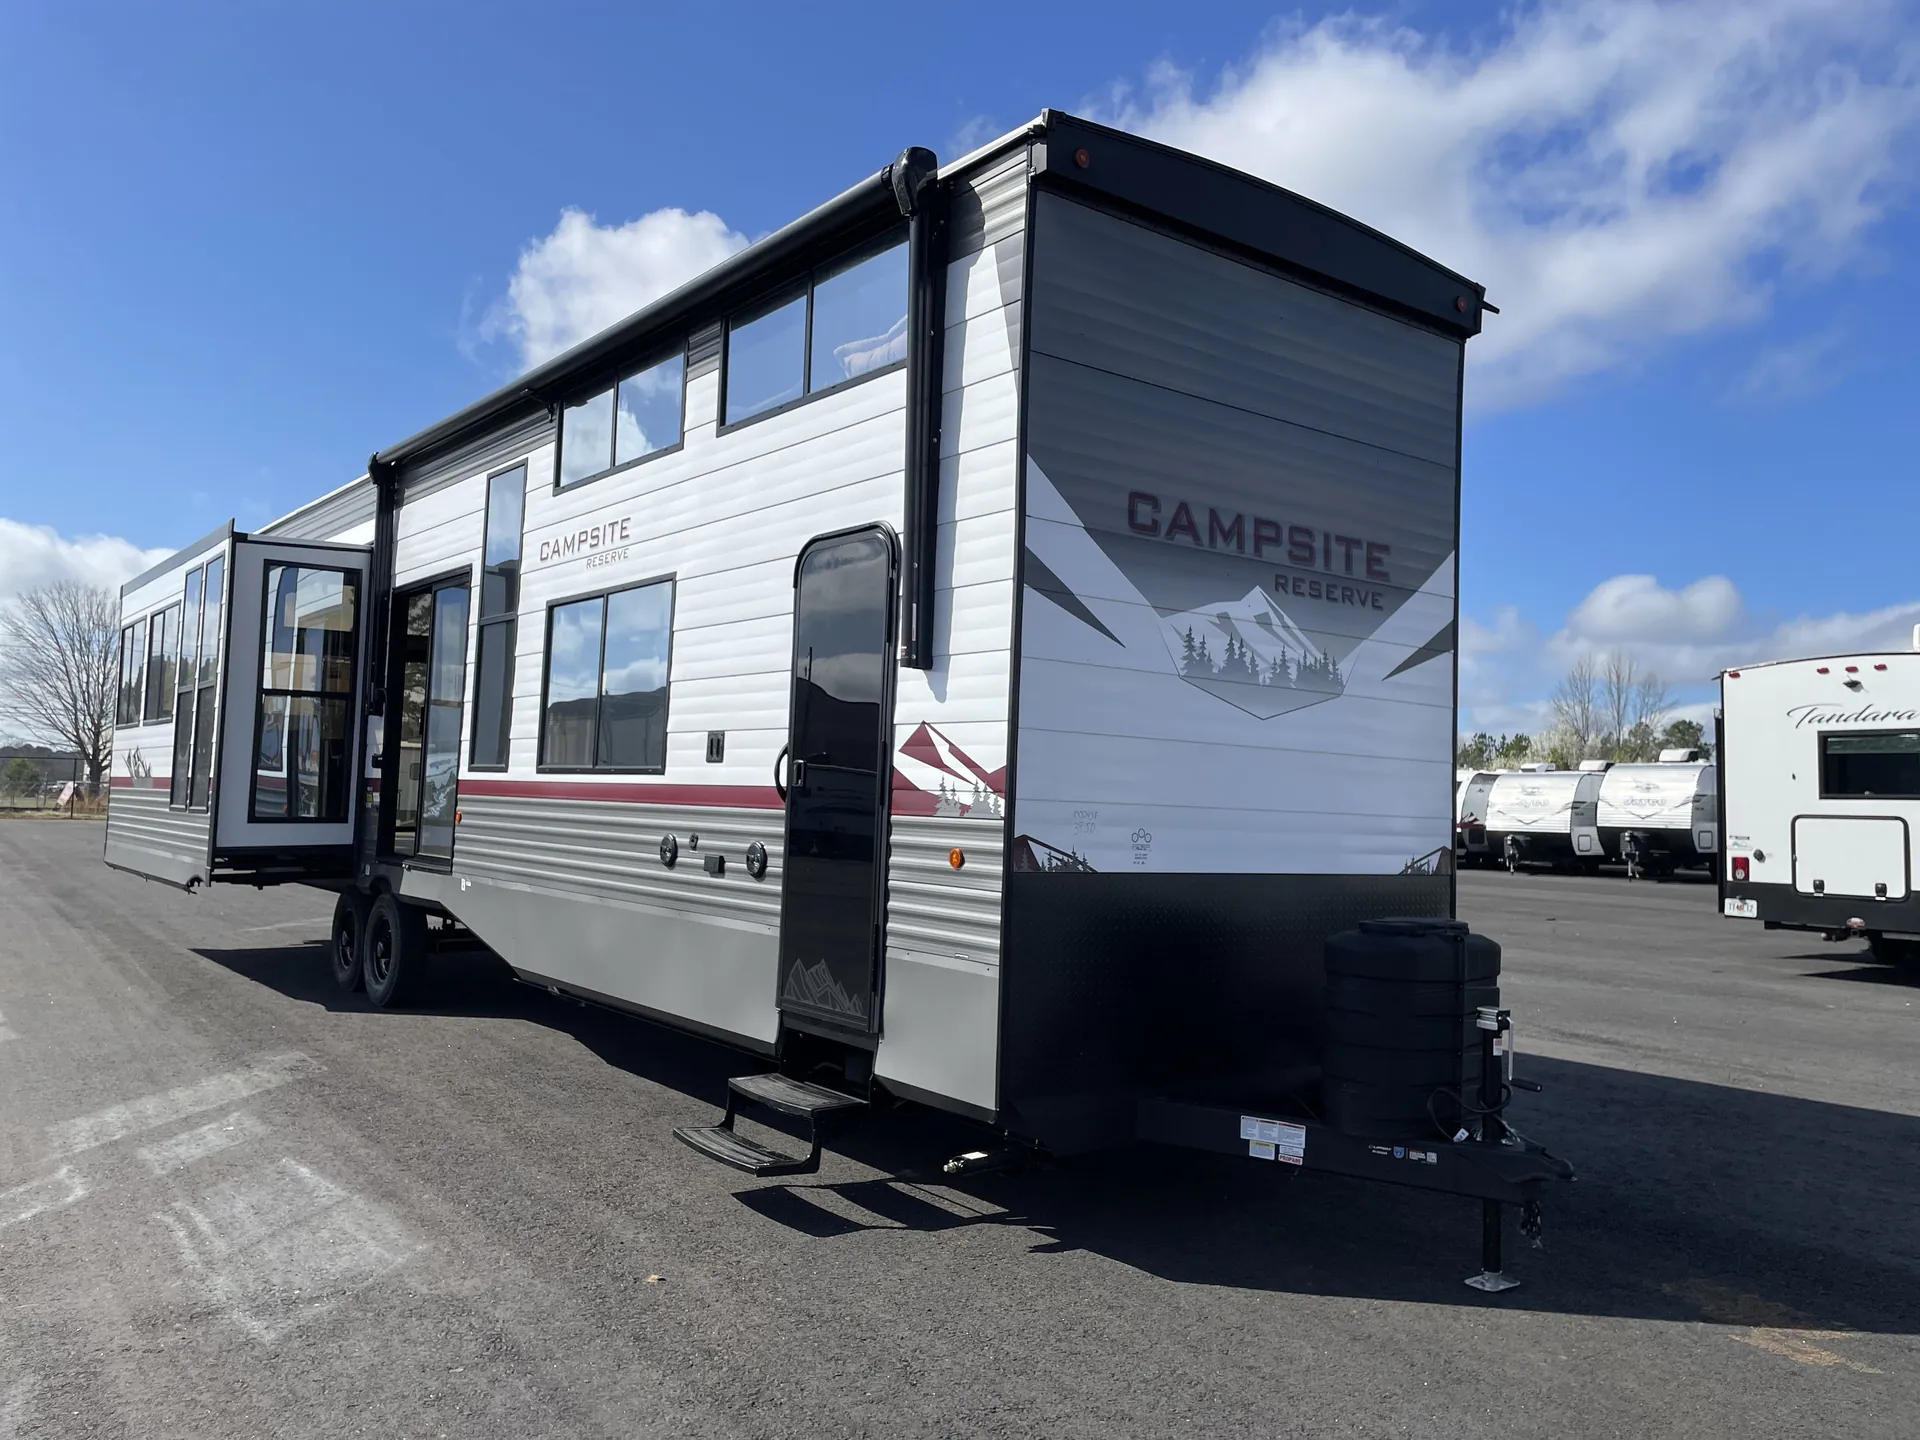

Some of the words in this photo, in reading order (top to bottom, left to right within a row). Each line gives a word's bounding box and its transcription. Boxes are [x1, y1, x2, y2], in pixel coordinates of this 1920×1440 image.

[540, 517, 631, 562] CAMPSITE
[1127, 491, 1391, 581] CAMPSITE
[586, 548, 629, 569] RESERVE
[1273, 573, 1385, 611] RESERVE
[1786, 703, 1920, 730] Tandara
